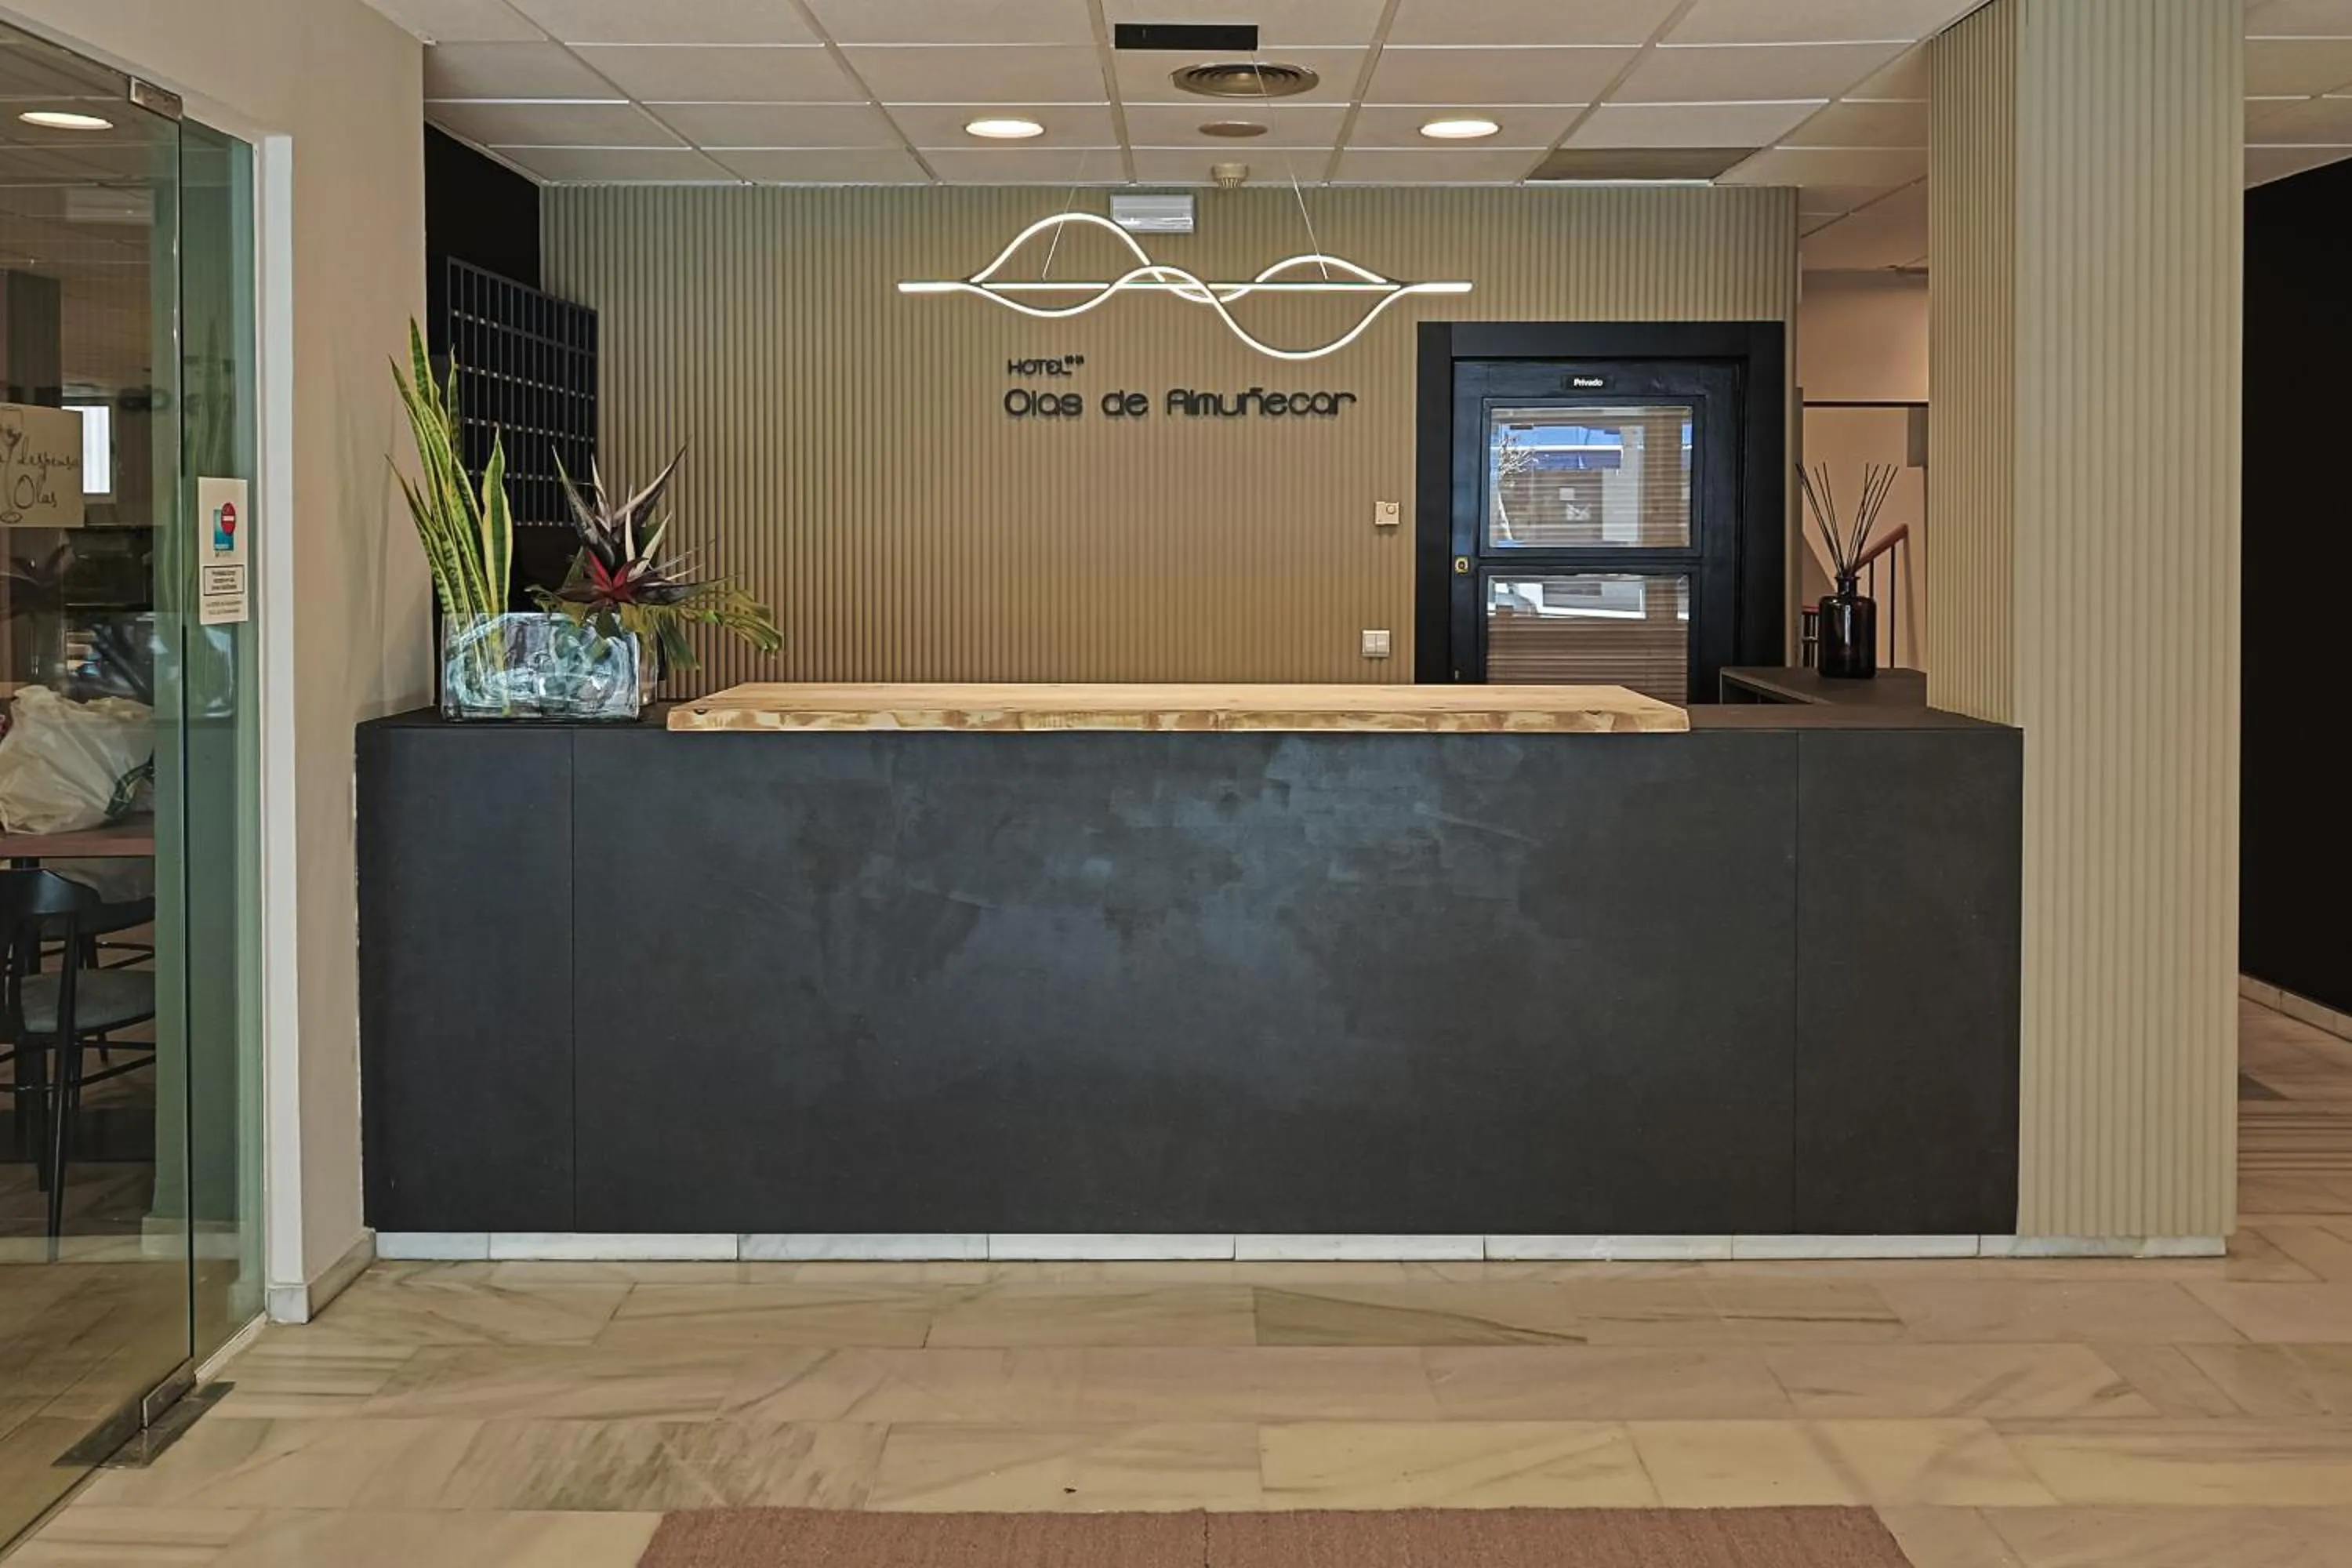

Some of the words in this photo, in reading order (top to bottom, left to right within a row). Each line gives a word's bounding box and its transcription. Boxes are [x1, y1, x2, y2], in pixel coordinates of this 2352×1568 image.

[1007, 358, 1072, 376] HOTEL
[1573, 378, 1603, 387] Privado
[1004, 389, 1083, 416] Olas
[1102, 390, 1149, 416] de
[1167, 387, 1356, 416] Almuñecar
[14, 474, 57, 509] Olas
